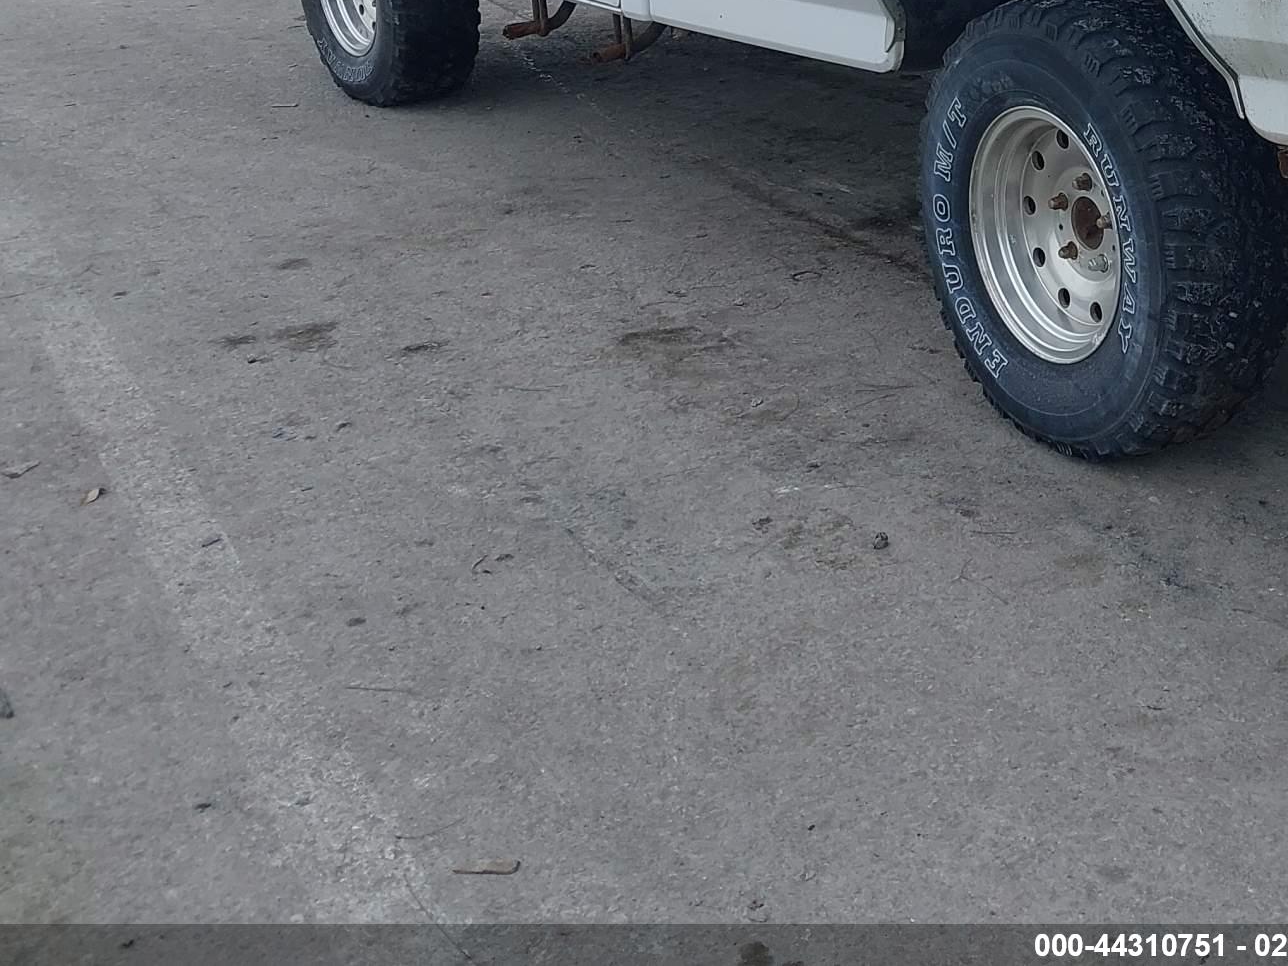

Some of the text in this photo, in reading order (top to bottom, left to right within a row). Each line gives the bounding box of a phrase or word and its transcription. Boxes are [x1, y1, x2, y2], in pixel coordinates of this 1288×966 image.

[932, 97, 1008, 379] ENDURO M/T
[1083, 122, 1139, 354] RUNWAY
